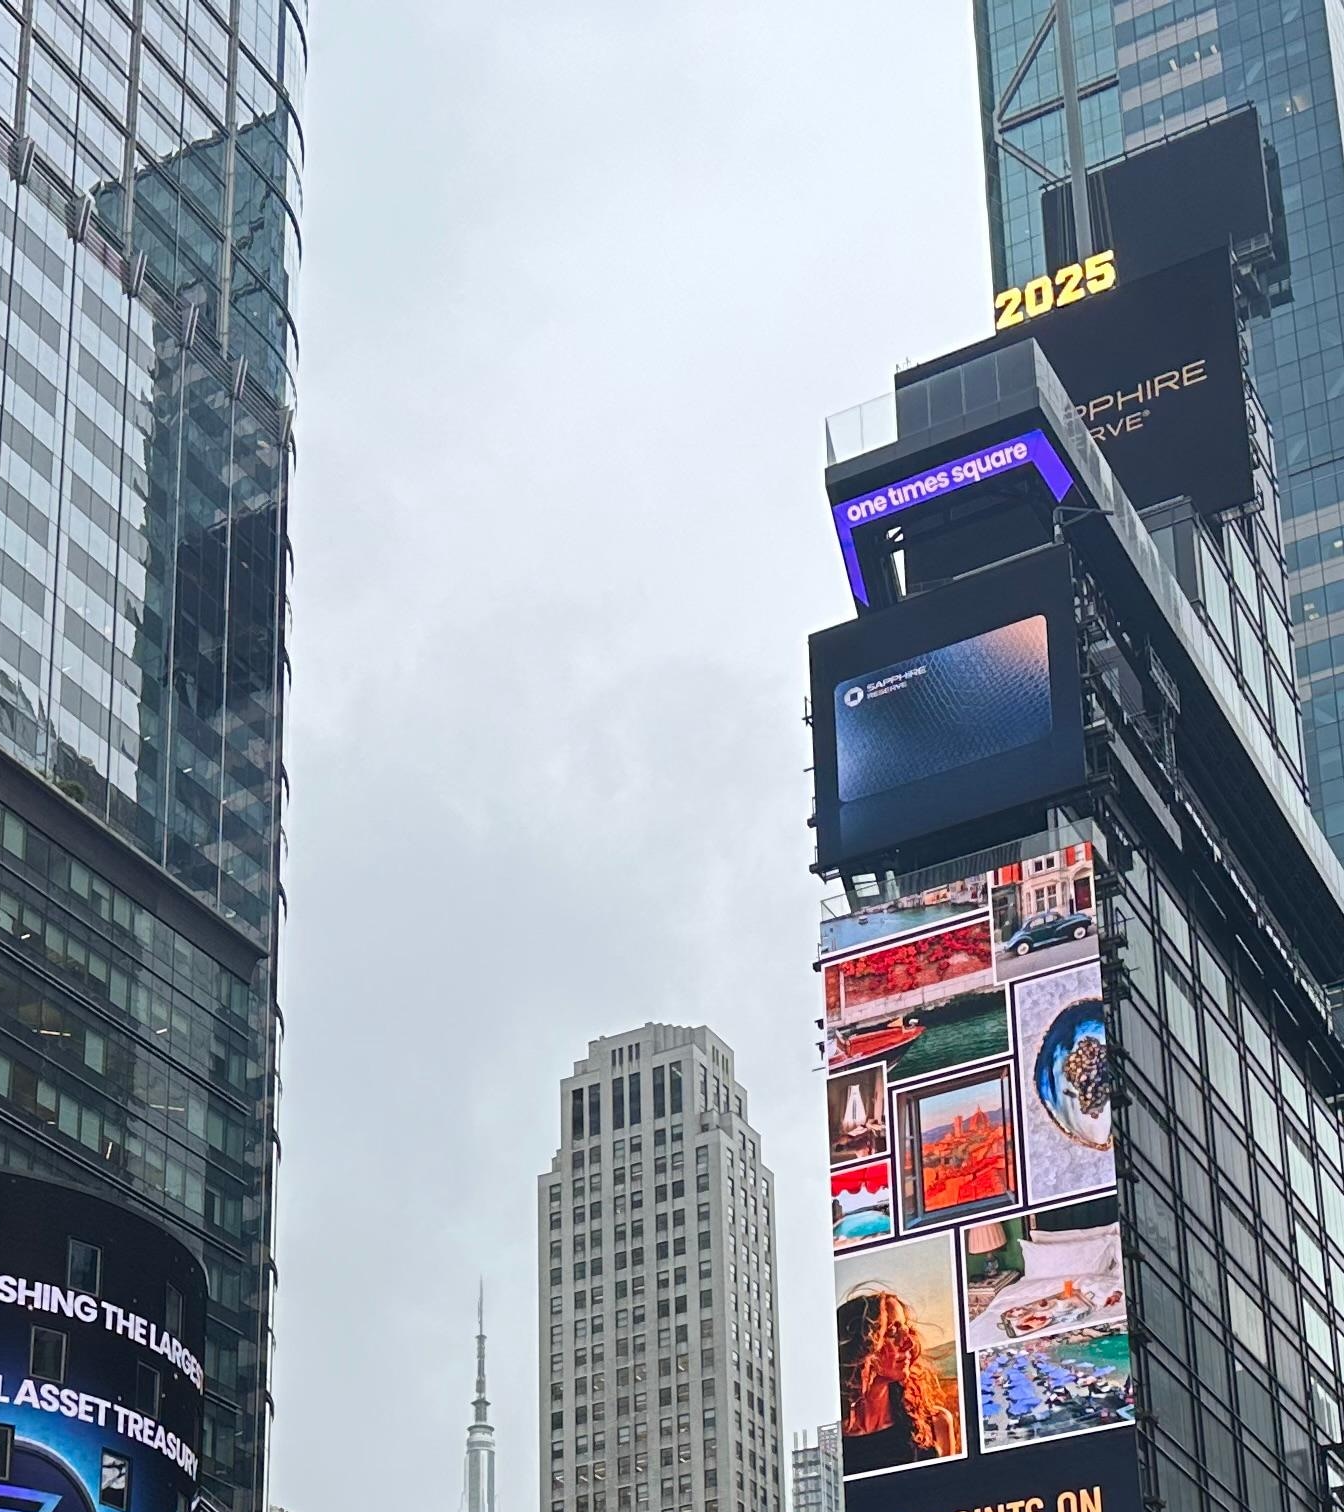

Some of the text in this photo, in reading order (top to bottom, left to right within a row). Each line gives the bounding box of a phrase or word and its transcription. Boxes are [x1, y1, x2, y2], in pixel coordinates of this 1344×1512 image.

[995, 249, 1117, 330] 2025
[847, 442, 1029, 522] one times square
[866, 664, 928, 692] SAPPHIRE
[866, 681, 908, 700] RESERVE
[100, 1300, 149, 1346] THE
[12, 1378, 112, 1427] ASSET
[113, 1404, 200, 1483] TREASURY
